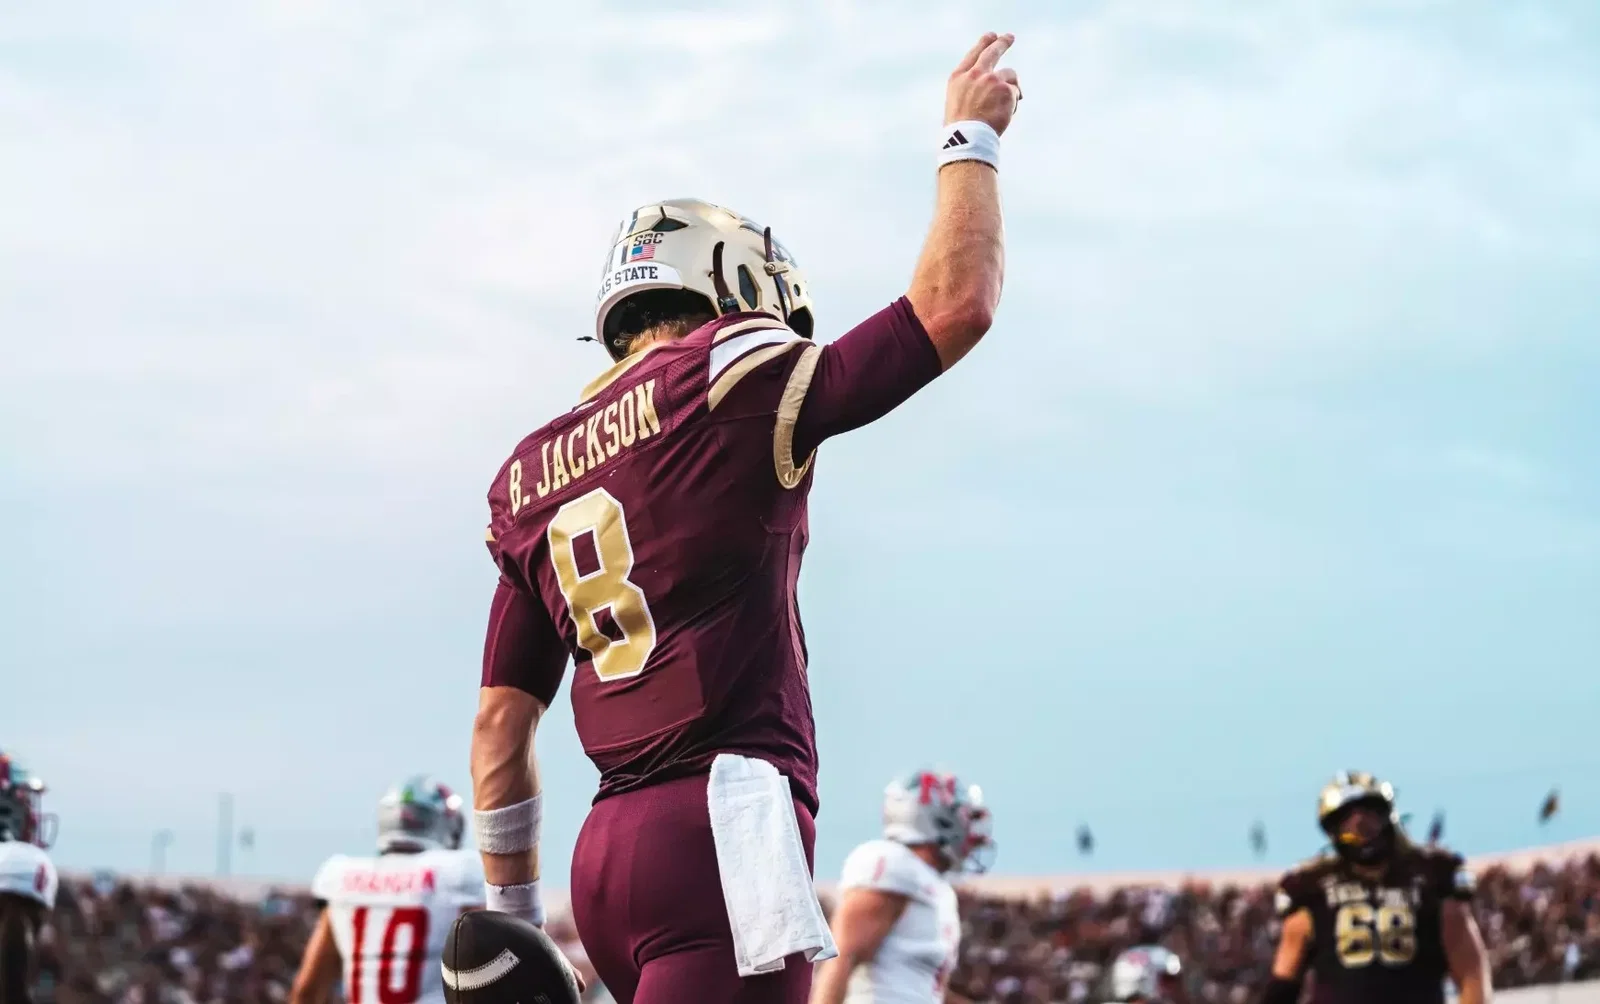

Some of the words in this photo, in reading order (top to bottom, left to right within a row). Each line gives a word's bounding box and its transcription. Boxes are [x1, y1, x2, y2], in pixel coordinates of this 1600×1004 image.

[614, 266, 658, 285] STATE
[508, 458, 531, 516] B.
[536, 378, 661, 499] JACKSON
[547, 486, 657, 682] 8
[348, 906, 430, 1004] 10
